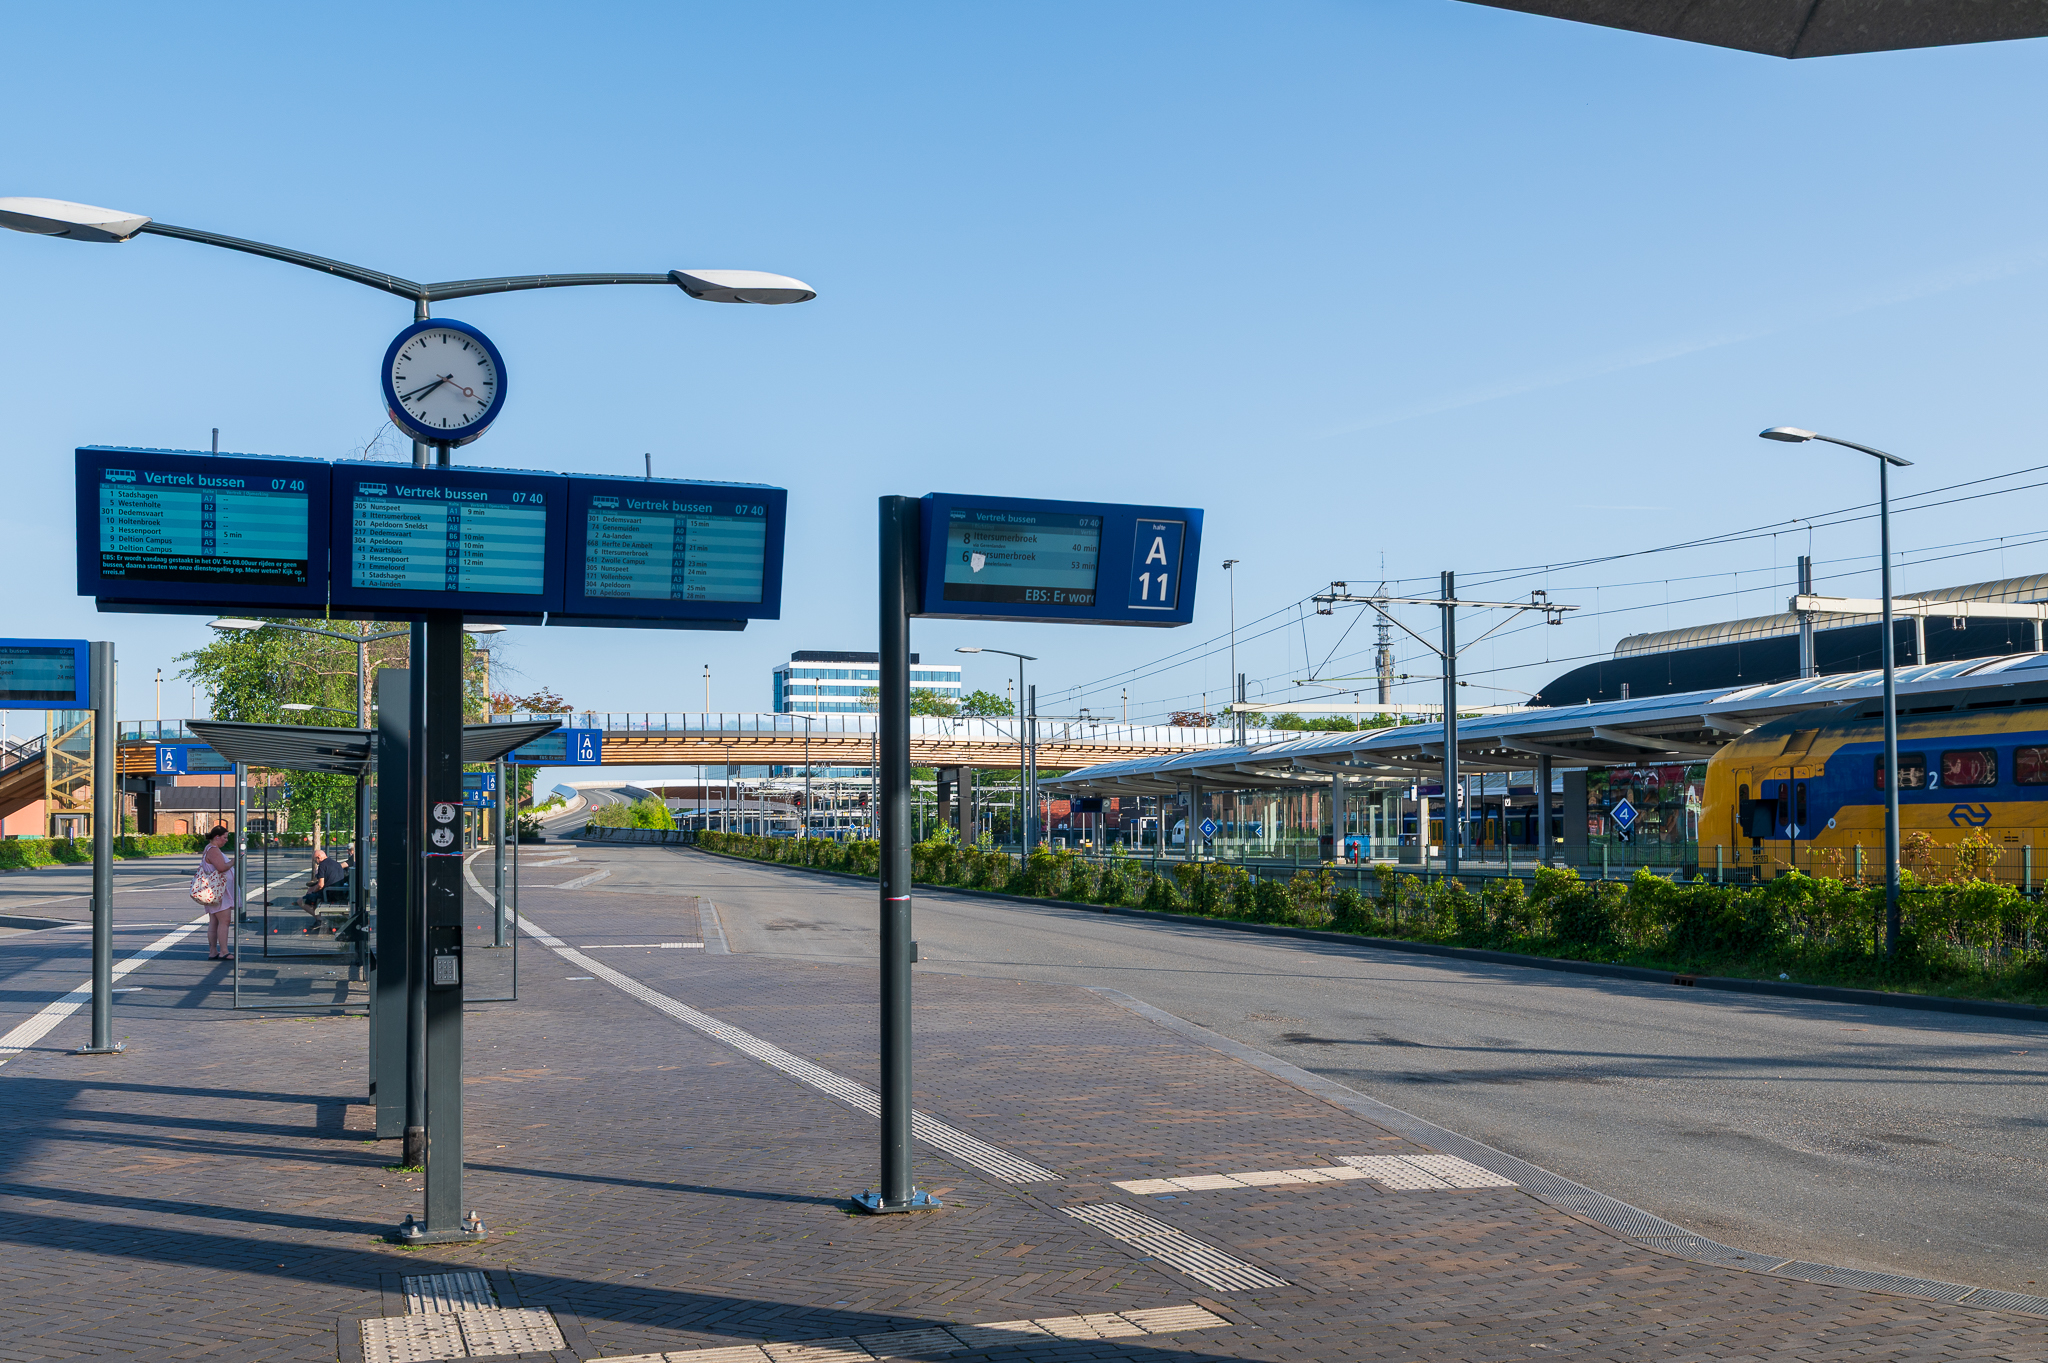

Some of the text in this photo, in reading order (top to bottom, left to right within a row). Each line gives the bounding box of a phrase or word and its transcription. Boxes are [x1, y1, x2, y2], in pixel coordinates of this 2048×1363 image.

[144, 472, 305, 491] Vertrek bussen 07 40
[118, 491, 158, 500] Stadshagen
[395, 485, 543, 504] Vertrek bussen 07 40
[118, 500, 161, 508] Westenholte
[370, 503, 400, 512] Nunspeet
[626, 498, 764, 516] Vertrek bussen 07 40
[118, 508, 163, 517] Dedemsvaart
[370, 512, 421, 521] Ittersumerbroek
[118, 517, 160, 526] Holtenbroek
[602, 516, 642, 524] Dedemsvaart
[976, 512, 1099, 527] Vertrek bussen 07 40
[370, 520, 403, 528] Apeldoorn
[404, 522, 428, 530] Sneldst
[602, 524, 640, 532] Genemuiden
[1152, 523, 1166, 531] halte
[118, 526, 161, 535] Hessenpoort
[370, 529, 411, 537] Dedemsvaart
[119, 535, 144, 543] Deltion
[145, 537, 172, 545] Campus
[369, 537, 402, 545] Apeldoorn
[963, 532, 1038, 545] 8 Ittersumerbroek
[119, 544, 144, 552] Deltion
[145, 545, 172, 554] Campus
[369, 546, 402, 554] Zwartsluis
[1072, 543, 1082, 552] 40
[1083, 544, 1097, 552] min
[1145, 536, 1167, 565] A
[601, 549, 649, 557] Ittersumerbroek
[962, 550, 969, 563] 6
[142, 556, 167, 564] vandaag
[259, 560, 274, 568] rijden
[369, 555, 409, 563] Hessenpoort
[193, 564, 234, 573] dienstregeling
[282, 568, 293, 576] Kijk
[369, 563, 405, 571] Emmeloord
[601, 565, 629, 573] Nunspeet
[1071, 561, 1096, 570] 53 min
[369, 572, 406, 580] Stadshagen
[600, 581, 631, 589] Apeldoorn
[1138, 572, 1168, 601] 11
[1025, 589, 1050, 602] EBS:
[1053, 590, 1066, 602] Er
[583, 738, 591, 748] A
[165, 751, 173, 761] A
[580, 749, 593, 759] 10
[166, 761, 172, 770] 2
[1929, 771, 1938, 790] 2
[1619, 807, 1629, 820] 4
[1205, 823, 1211, 832] 6
